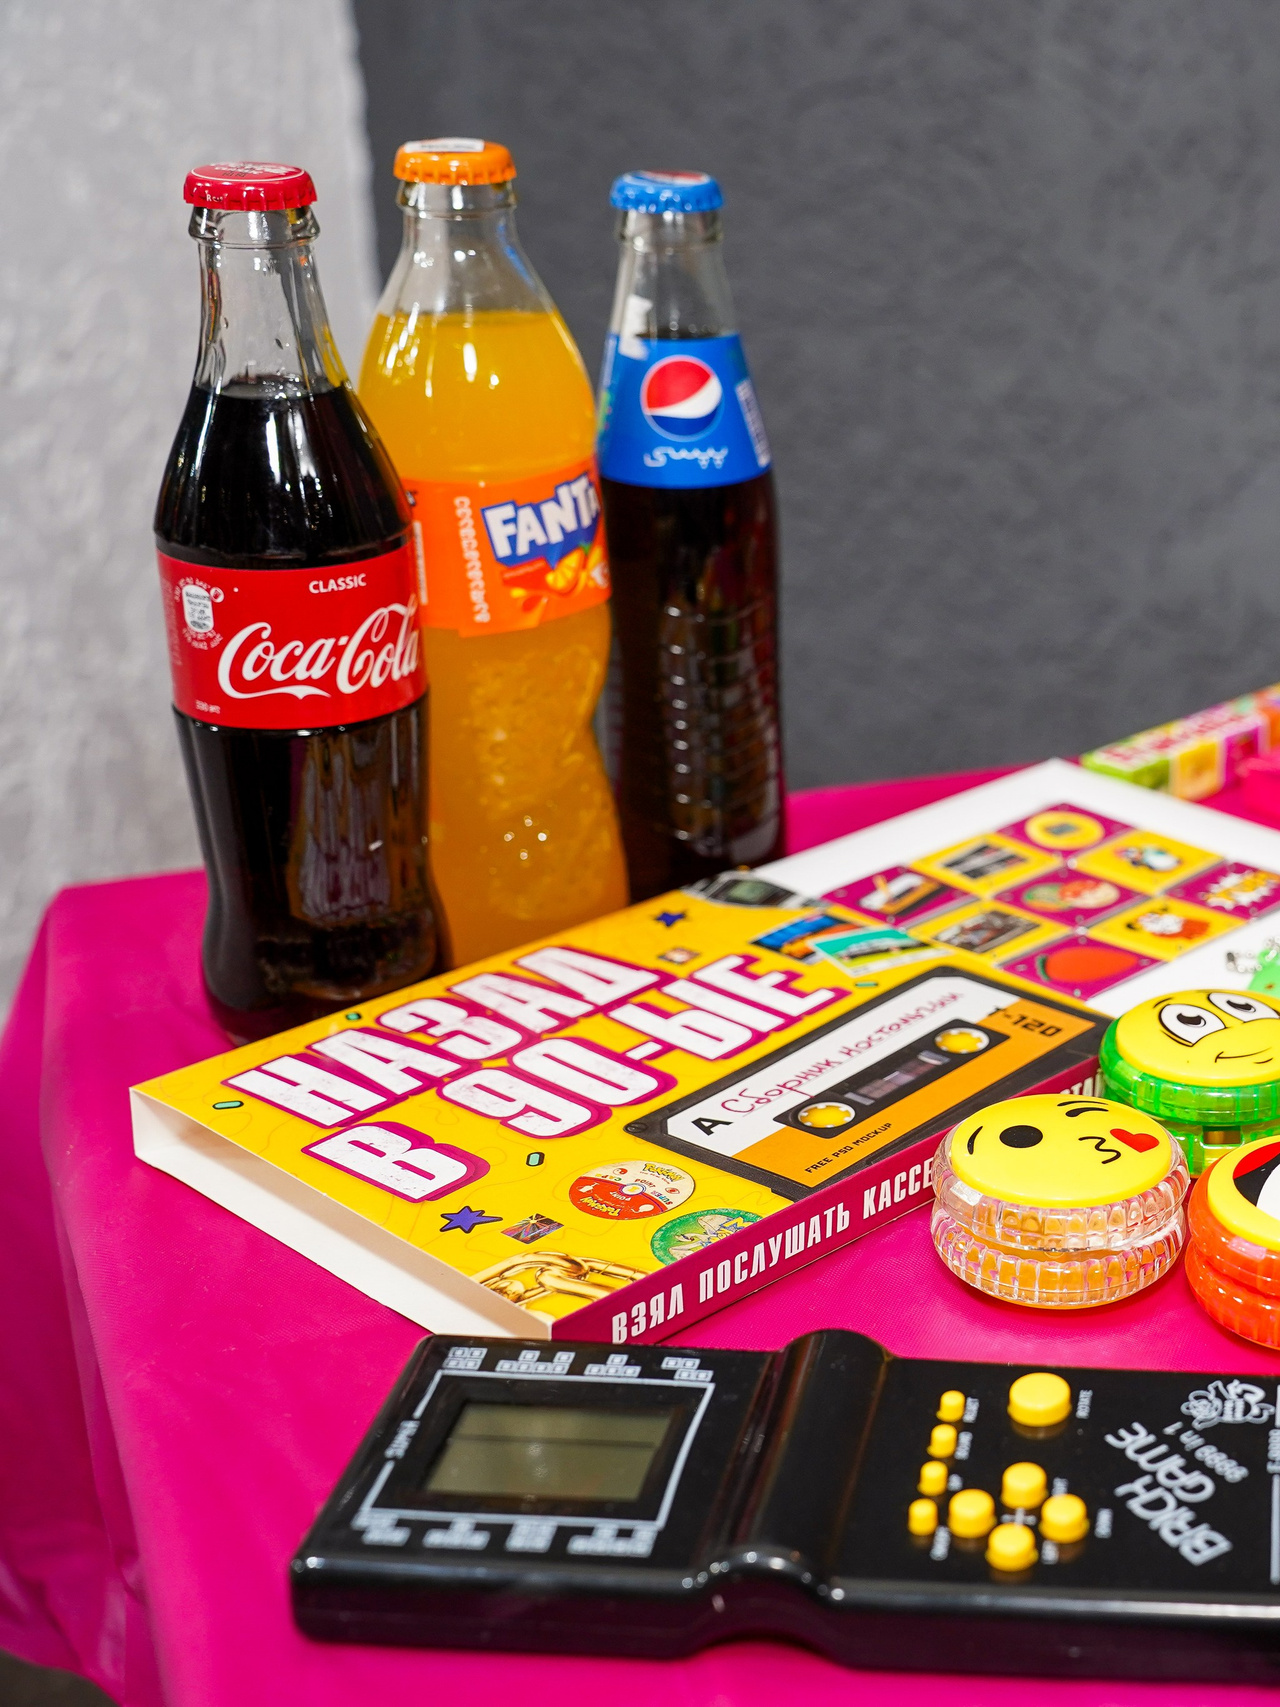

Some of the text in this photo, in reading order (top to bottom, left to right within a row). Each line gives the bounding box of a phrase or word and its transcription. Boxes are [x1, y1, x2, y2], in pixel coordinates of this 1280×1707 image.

[308, 573, 367, 595] CLASSIC
[217, 594, 420, 700] Coca-Cola
[228, 946, 661, 1127] НАЗАД
[309, 955, 836, 1200] В 90-ЫЕ
[721, 1057, 842, 1113] Сборник
[805, 1122, 893, 1174] FREE PSD MOCKUP
[611, 1283, 684, 1344] ВЗЯЛ
[699, 1202, 850, 1304] ПОСЛУШАТЬ
[862, 1156, 934, 1220] КАССЕ
[1104, 1421, 1216, 1503] GAME
[1162, 1421, 1249, 1483] 9999 in 1
[1113, 1474, 1233, 1566] BRICK
